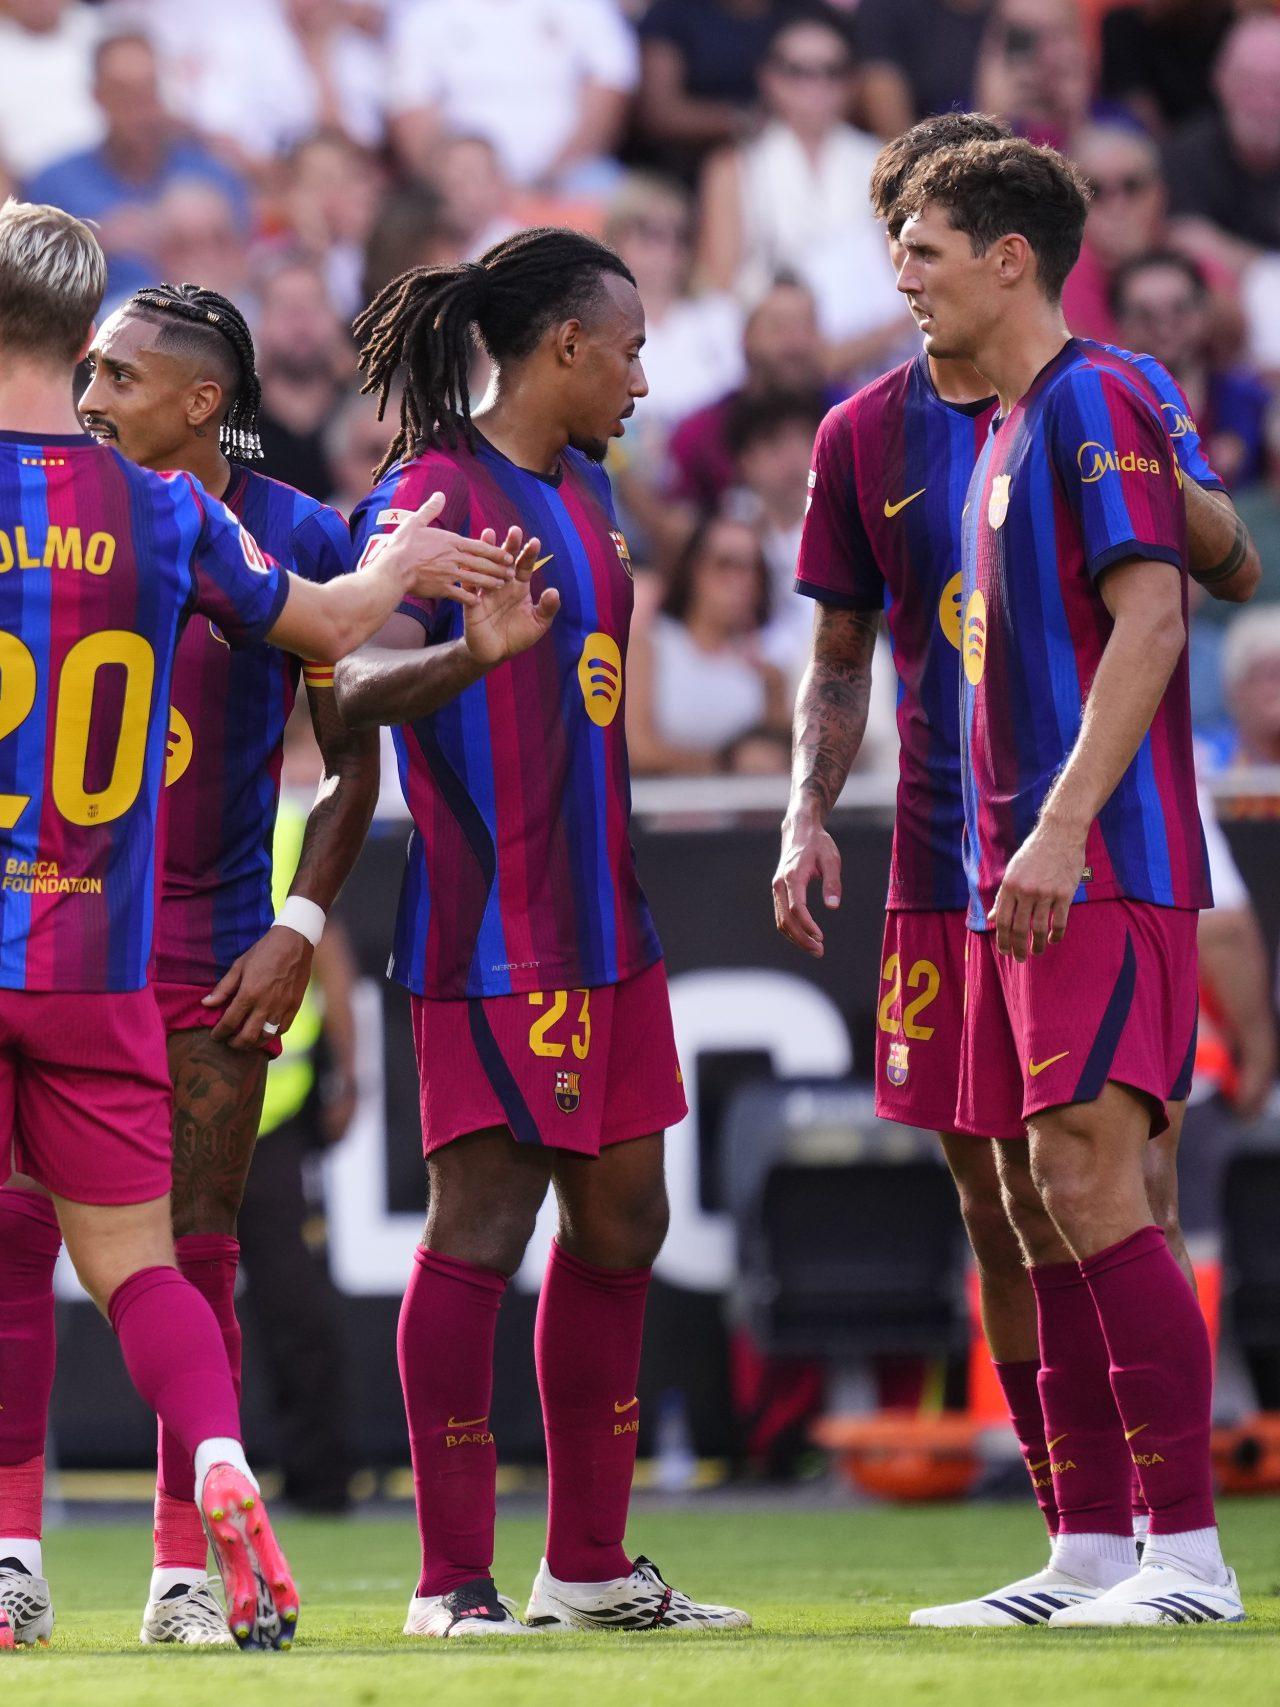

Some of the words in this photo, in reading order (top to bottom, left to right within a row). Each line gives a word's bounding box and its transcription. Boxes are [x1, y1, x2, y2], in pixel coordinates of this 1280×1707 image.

[1077, 441, 1160, 482] Midea
[5, 857, 60, 879] BARÇA
[1, 875, 103, 894] FOUNDATION
[878, 952, 941, 1041] 22
[528, 988, 591, 1060] 23
[446, 1431, 495, 1447] BARÇA
